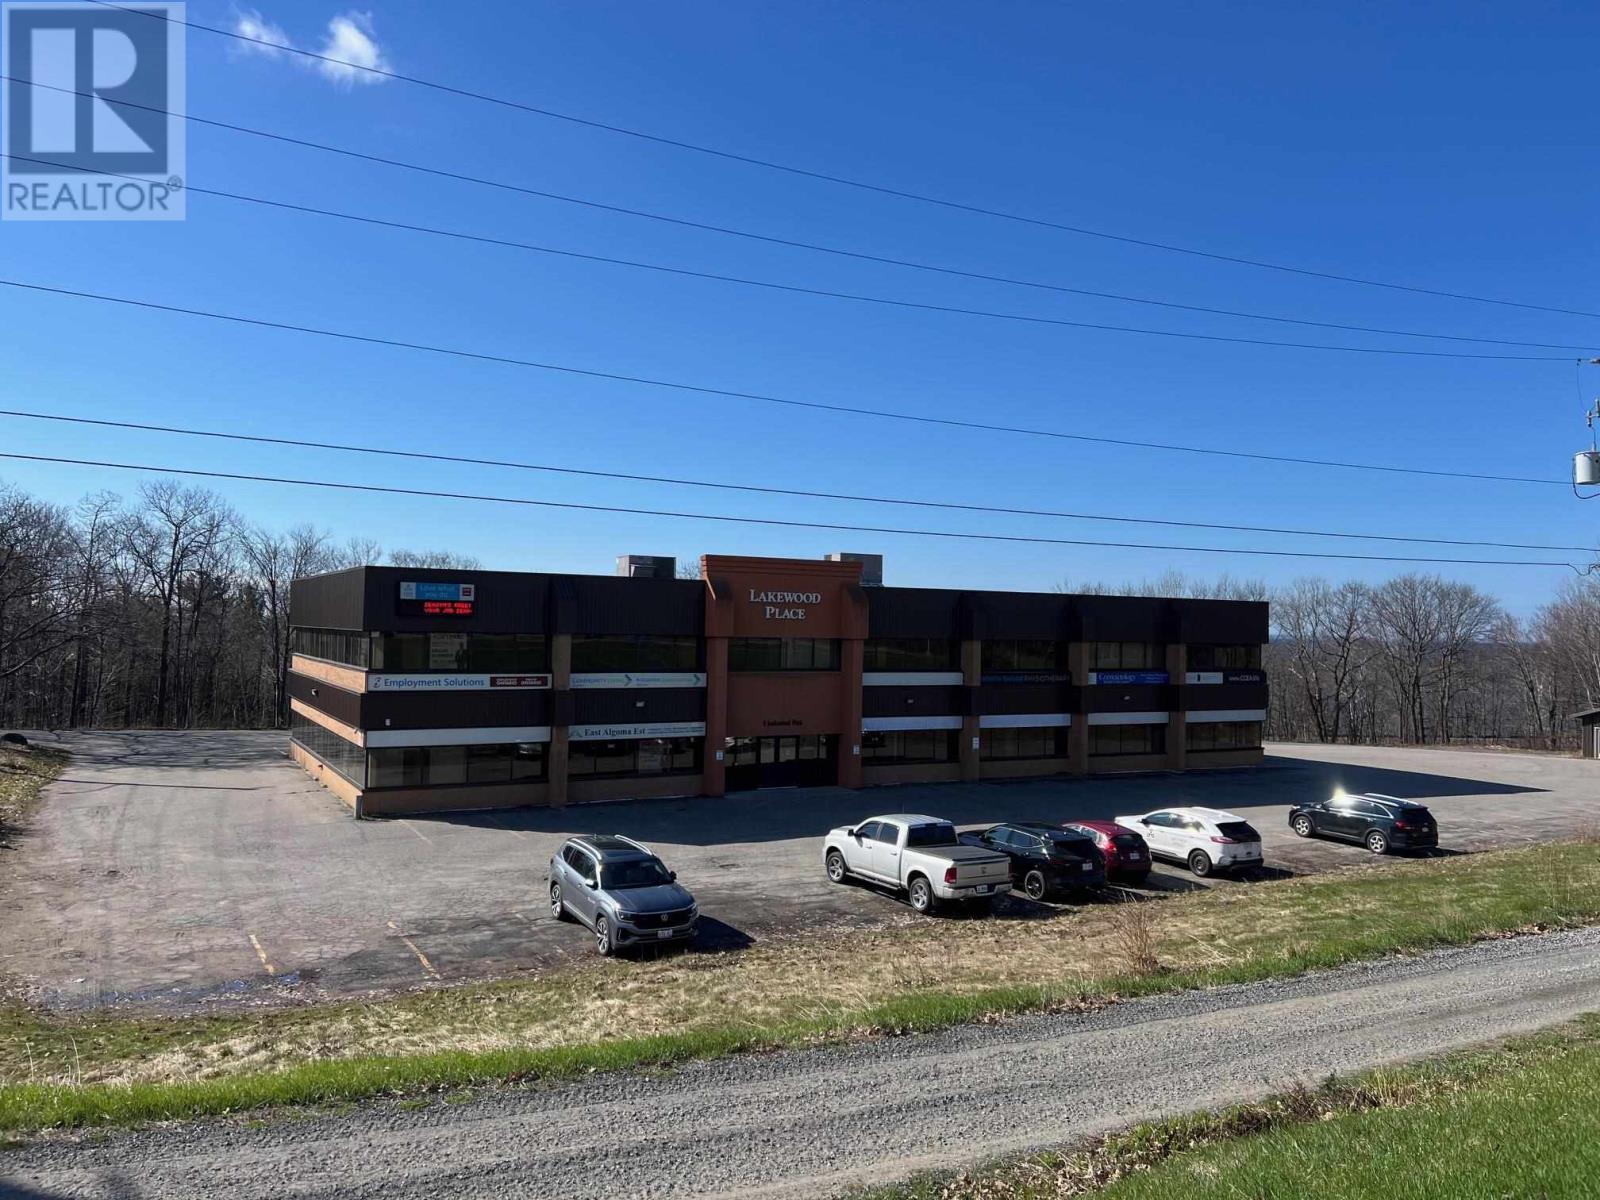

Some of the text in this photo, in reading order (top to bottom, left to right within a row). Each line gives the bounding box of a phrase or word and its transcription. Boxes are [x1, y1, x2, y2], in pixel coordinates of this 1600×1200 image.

[749, 589, 821, 604] LAKEWOOD
[766, 606, 806, 620] PLACE
[383, 677, 442, 688] Employment
[444, 677, 485, 687] Solutions
[584, 728, 601, 737] East
[602, 727, 632, 737] Algoma
